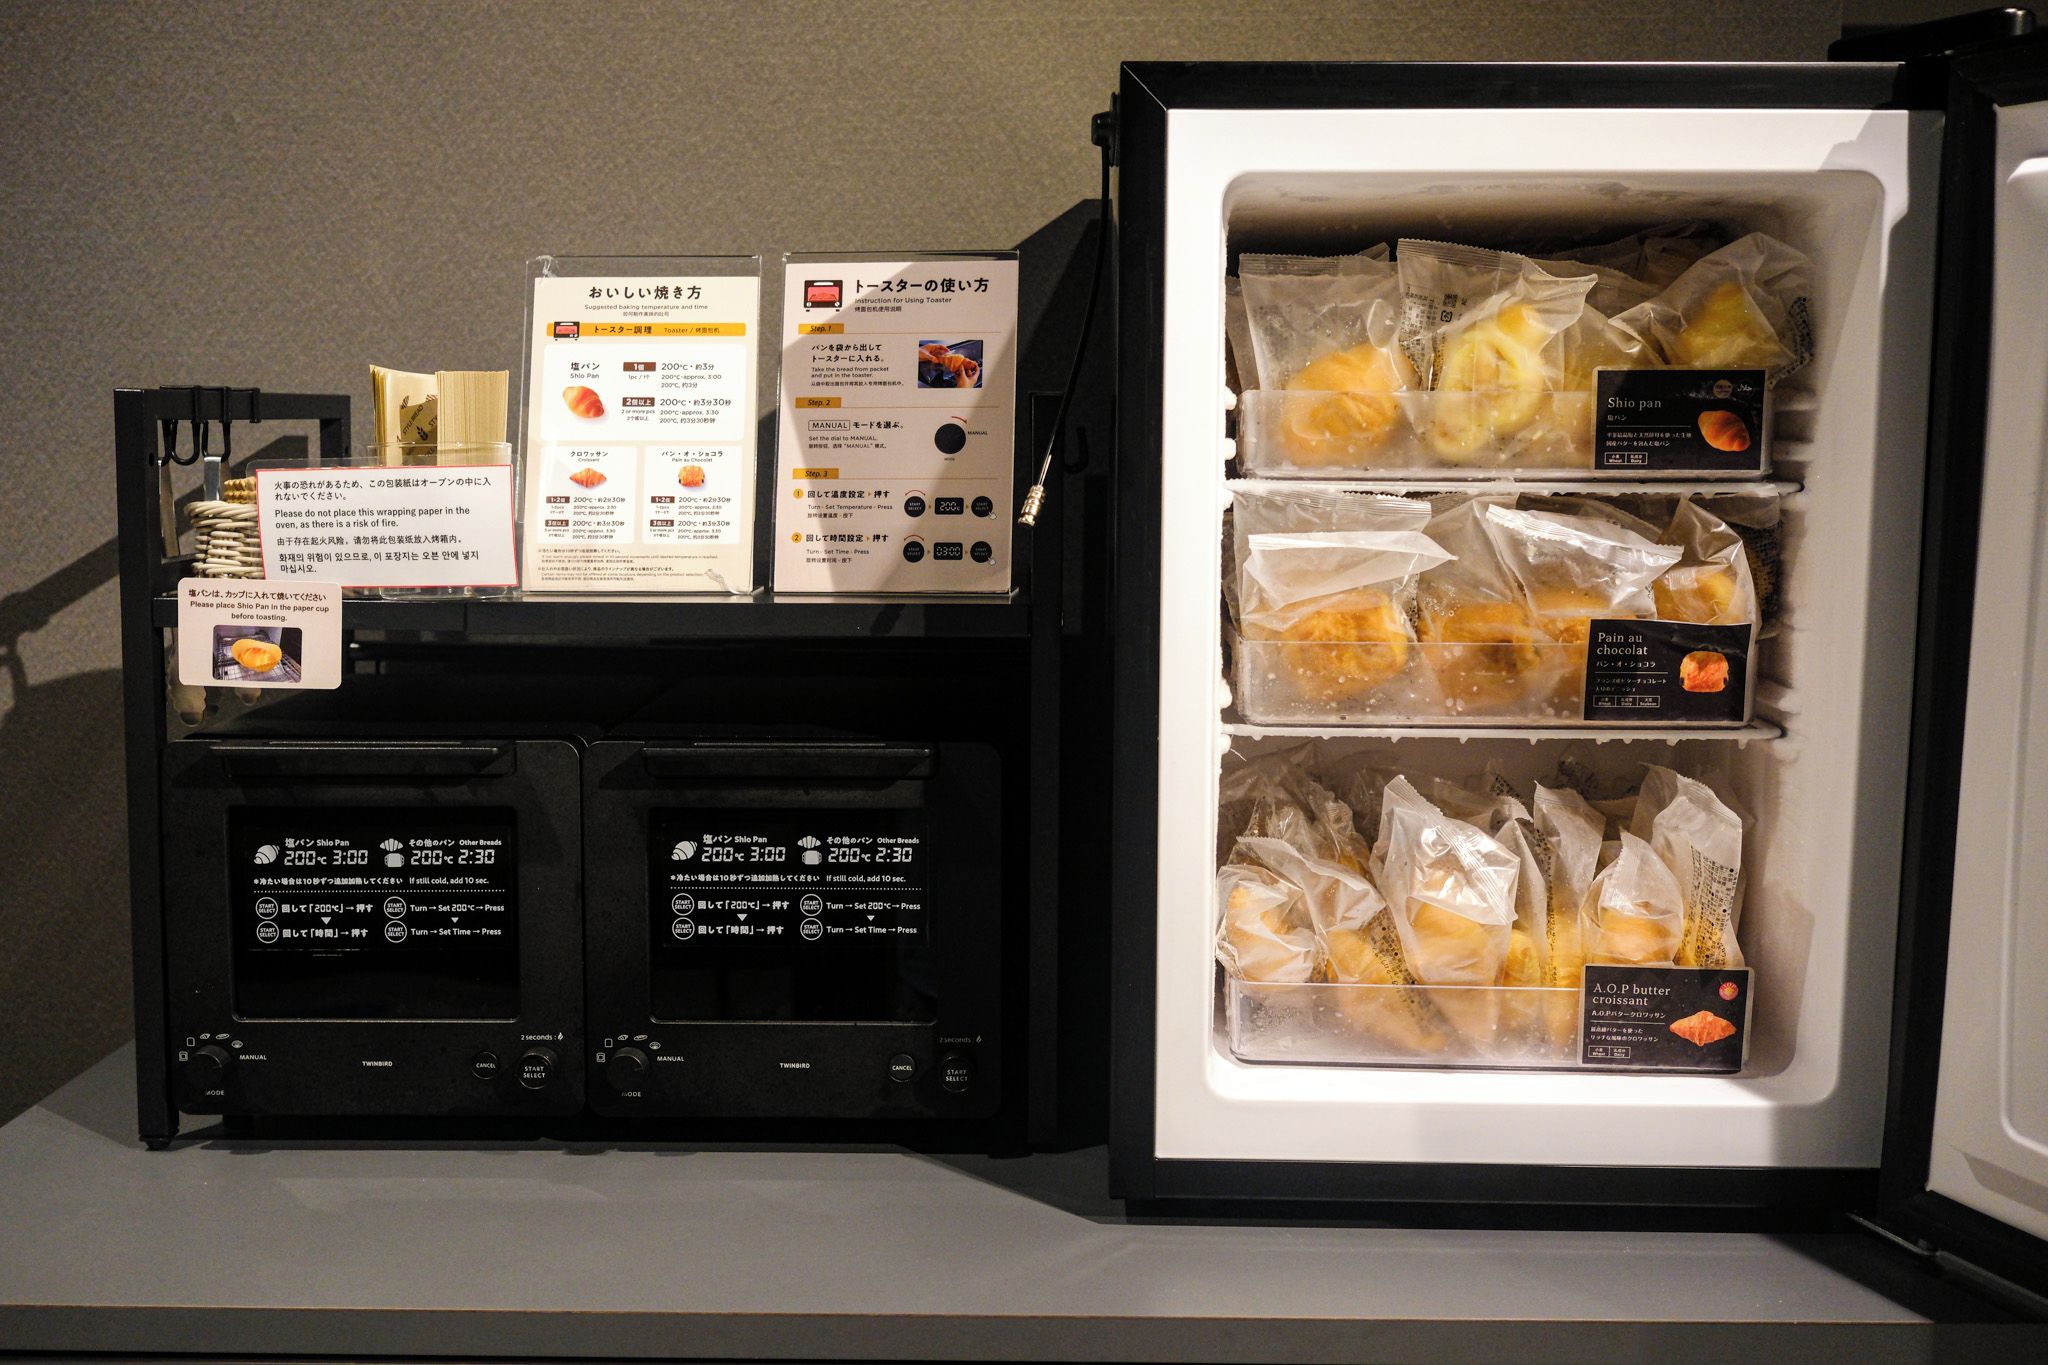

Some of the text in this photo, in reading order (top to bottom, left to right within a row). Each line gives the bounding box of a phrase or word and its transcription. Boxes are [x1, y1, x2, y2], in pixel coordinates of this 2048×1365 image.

[856, 277, 989, 294] トースターの使い方
[589, 285, 702, 300] おいしい焼き方
[593, 325, 654, 335] トースター調理
[811, 344, 882, 352] パンを袋から出して
[812, 354, 884, 363] トースターに入れる。
[571, 362, 600, 371] 塩パン
[1607, 397, 1661, 411] Shio pan
[812, 421, 903, 430] MANUAL モードを選ぶ。
[274, 477, 491, 490] 火事の恐れがあるため、この包装紙はオーブンの中に入
[275, 491, 346, 501] れないでください。
[807, 490, 890, 498] 回して温度設定 押す
[275, 506, 470, 518] Please do not place this wrapping paper in the
[312, 520, 334, 528] there
[336, 520, 344, 528] is
[353, 519, 369, 527] risk
[370, 518, 379, 527] of
[381, 518, 399, 527] fire.
[806, 534, 889, 542] 回して時間設定 押す
[279, 550, 479, 563] 화재의 위험이 있으므로, 이 포장지는 오븐 안에 넣지
[280, 564, 317, 573] 마십시오.
[188, 589, 326, 602] 塩パンは、カップに入れて焼いてください
[190, 600, 214, 608] Please
[256, 614, 287, 622] toasting.
[1598, 632, 1624, 642] Pain
[1597, 644, 1648, 655] chocolat
[285, 838, 314, 848] 塩パン
[409, 839, 455, 847] その他のパン
[703, 834, 732, 844] 塩パン
[734, 835, 752, 843] Shio
[826, 836, 873, 845] その他のパン
[332, 850, 368, 865] 3:00
[458, 849, 495, 864] 2:30
[749, 846, 786, 862] 3:00
[875, 847, 912, 862] 2:30
[430, 877, 449, 885] cold,
[356, 904, 373, 913] 押す
[410, 904, 428, 912] Turn
[351, 928, 368, 938] 押す
[1593, 983, 1671, 995] A.O.P butter
[1593, 995, 1648, 1006] croissant
[1592, 1010, 1666, 1019] A.O.Pバタークロワッサン
